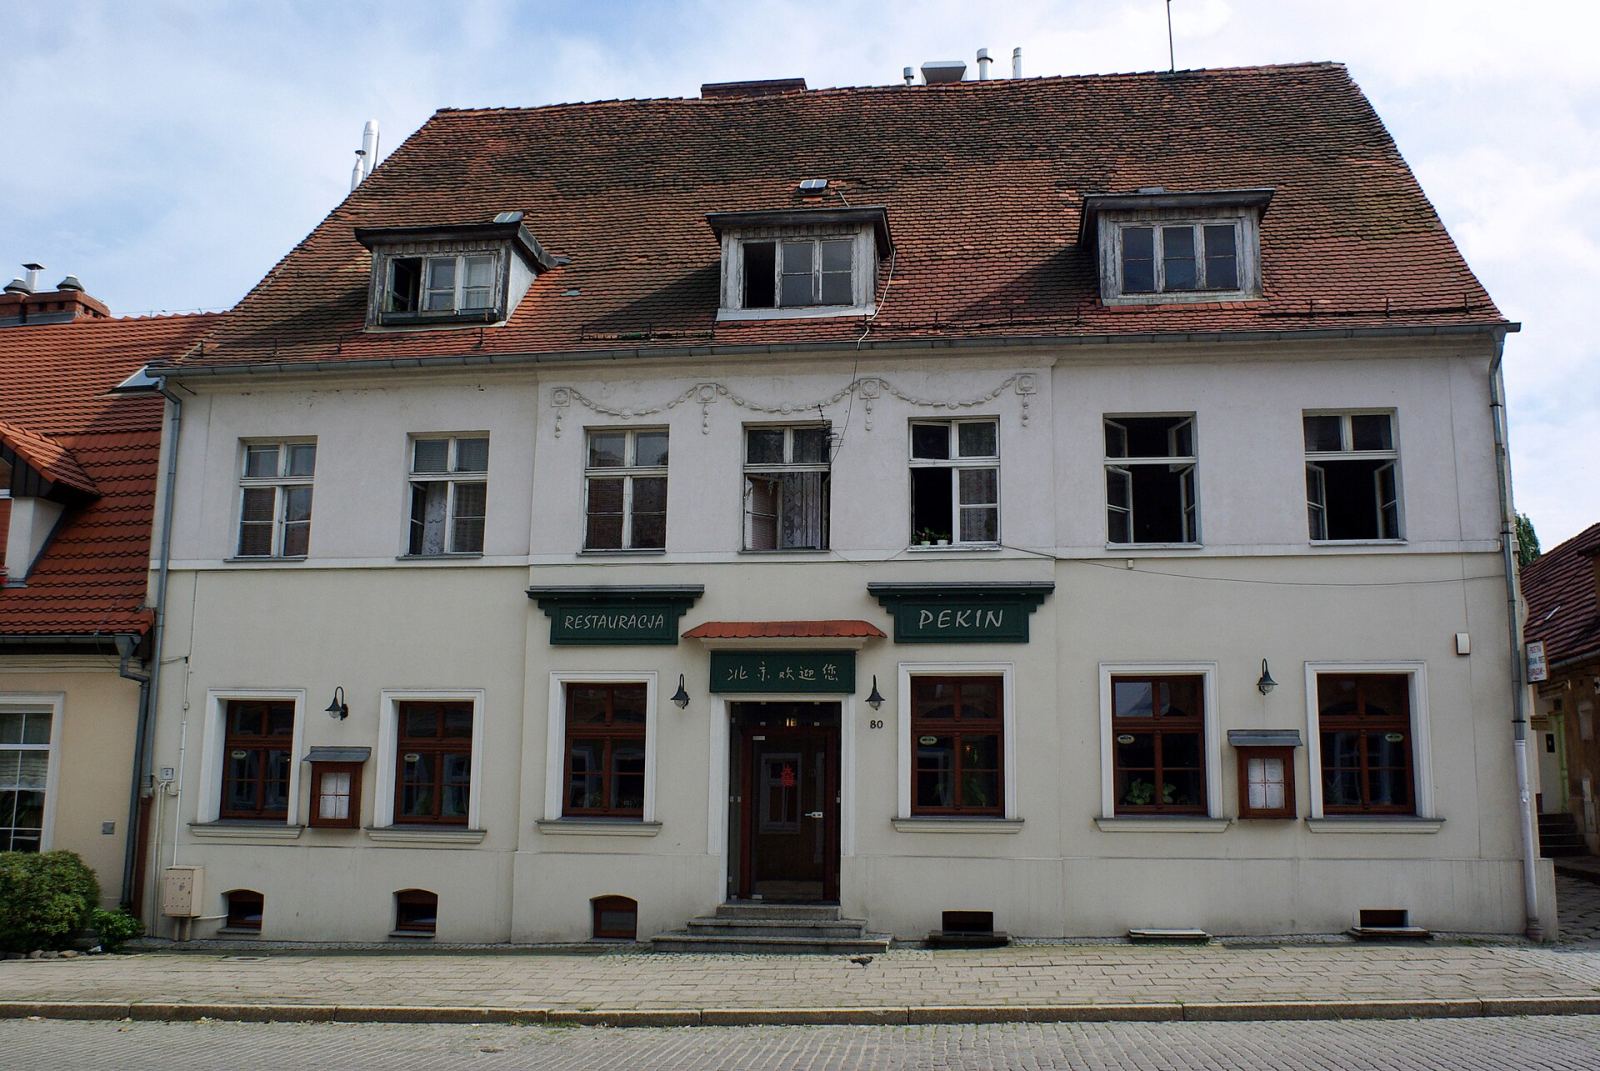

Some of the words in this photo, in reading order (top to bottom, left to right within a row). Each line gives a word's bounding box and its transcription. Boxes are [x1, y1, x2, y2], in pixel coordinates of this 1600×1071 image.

[564, 614, 664, 630] RESTAURACJA
[919, 609, 1004, 629] PEKIN
[727, 661, 838, 681] 北京欢迎您
[869, 719, 884, 730] 80
